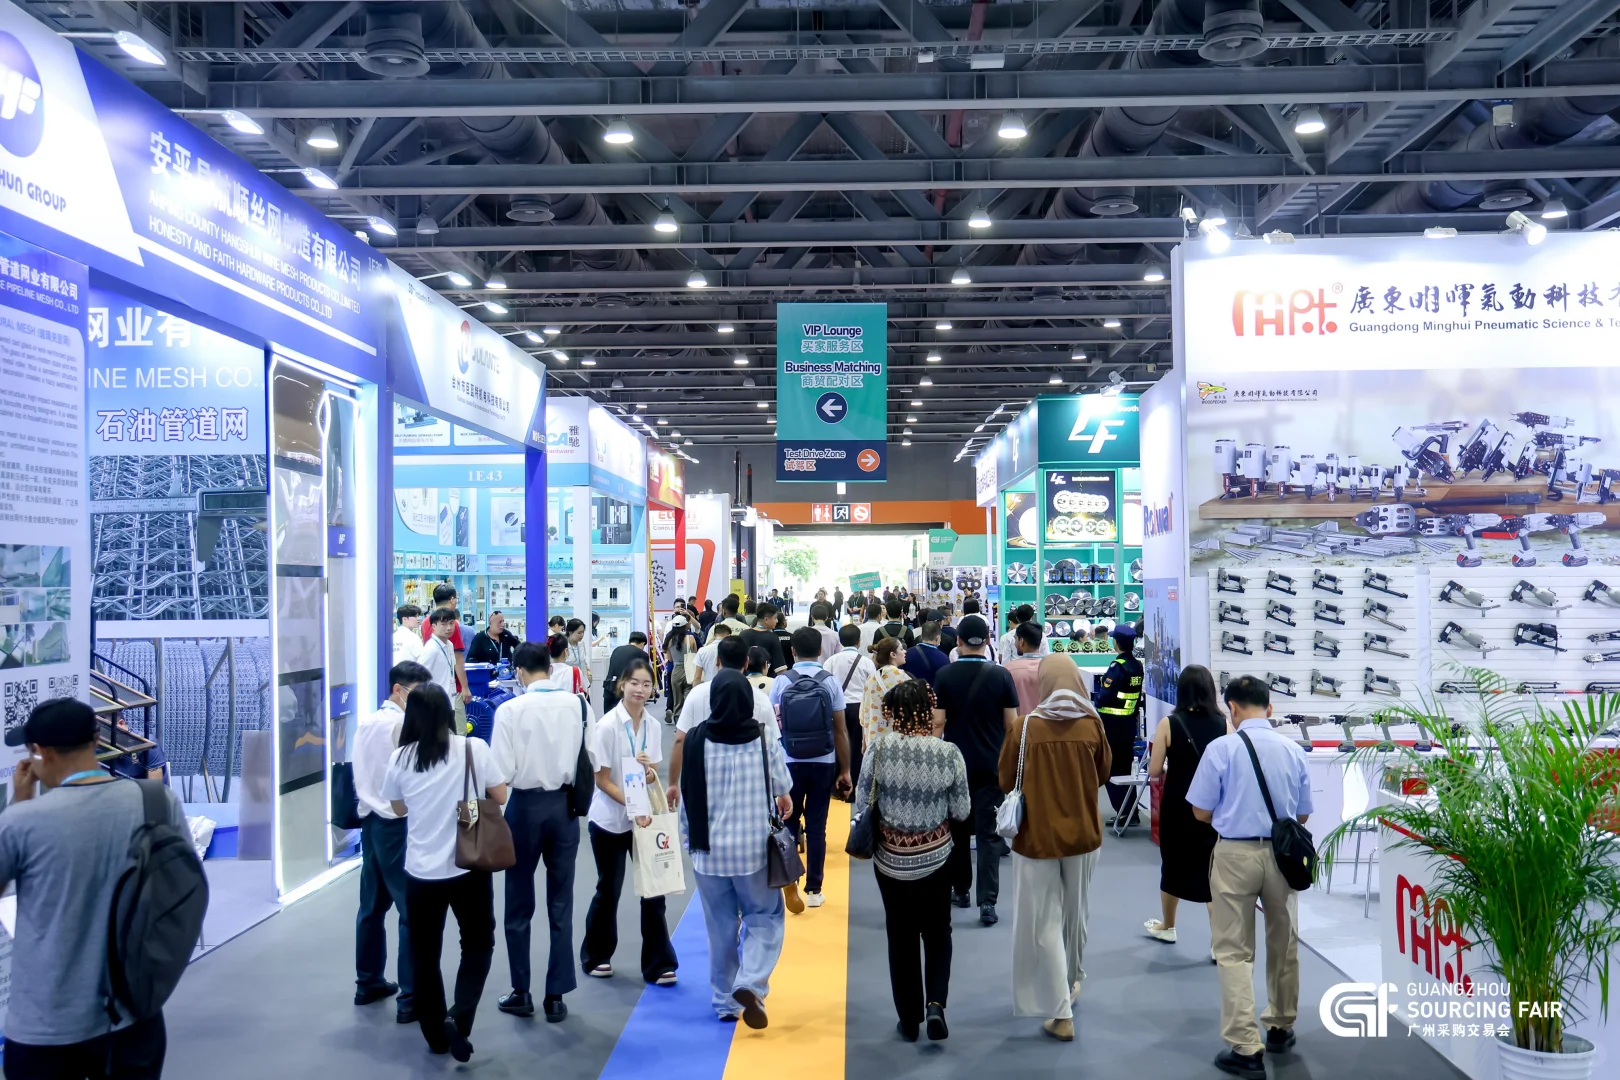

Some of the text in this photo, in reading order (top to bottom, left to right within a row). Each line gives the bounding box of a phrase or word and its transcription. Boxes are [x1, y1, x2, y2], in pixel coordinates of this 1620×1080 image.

[27, 181, 67, 213] GROUP
[185, 208, 220, 240] COUNTY
[281, 260, 299, 282] MESH
[300, 270, 332, 300] PRODUCTS
[150, 214, 193, 249] HONESTY
[194, 238, 212, 260] AND
[213, 248, 235, 271] FAITH
[236, 258, 276, 292] HARDWARE
[276, 279, 310, 309] PRODUCTS
[6, 281, 36, 300] PIPELINE
[36, 291, 54, 306] MESH
[67, 303, 79, 315] LTD
[803, 324, 862, 337] VIP Lounge
[1350, 322, 1419, 334] Guangdong
[1423, 321, 1471, 333] Minghui
[1475, 320, 1538, 330] Pneumatic
[1543, 318, 1590, 329] Science
[1595, 318, 1603, 328] &
[801, 340, 863, 353] 买家服务区
[785, 361, 881, 374] Business Matching
[136, 367, 207, 389] MESH
[801, 375, 863, 388] 商贸配对区
[95, 406, 249, 442] 石油管道网
[784, 448, 846, 459] Test Drive Zone
[784, 459, 816, 471] 试驾区
[468, 470, 503, 482] 1E43
